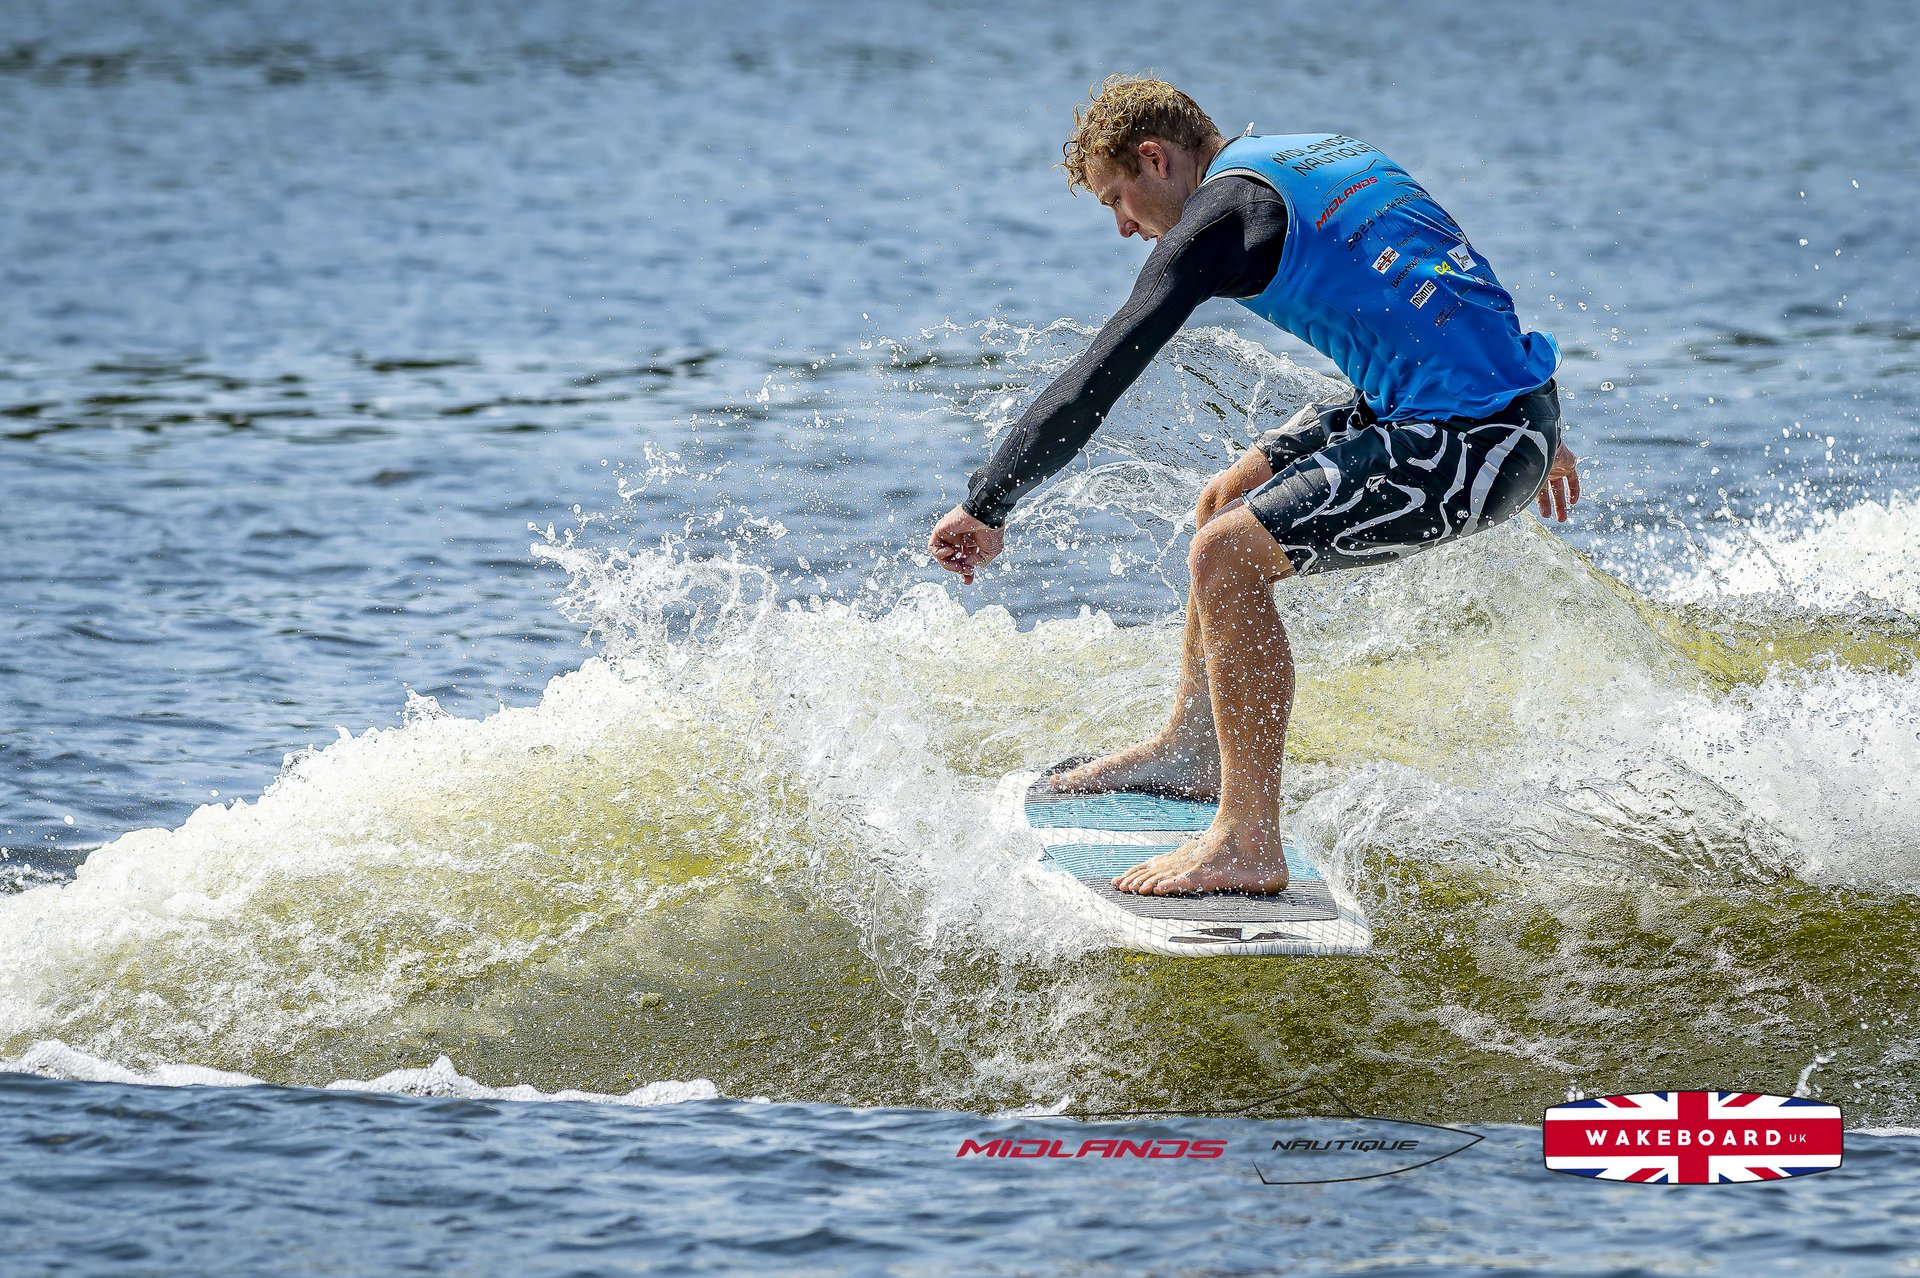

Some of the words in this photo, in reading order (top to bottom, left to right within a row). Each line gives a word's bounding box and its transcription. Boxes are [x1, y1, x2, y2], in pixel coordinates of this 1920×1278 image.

[1273, 135, 1355, 165] MIDLANDS
[1315, 176, 1378, 231] MIDLANDS
[1411, 281, 1436, 308] MANTIS
